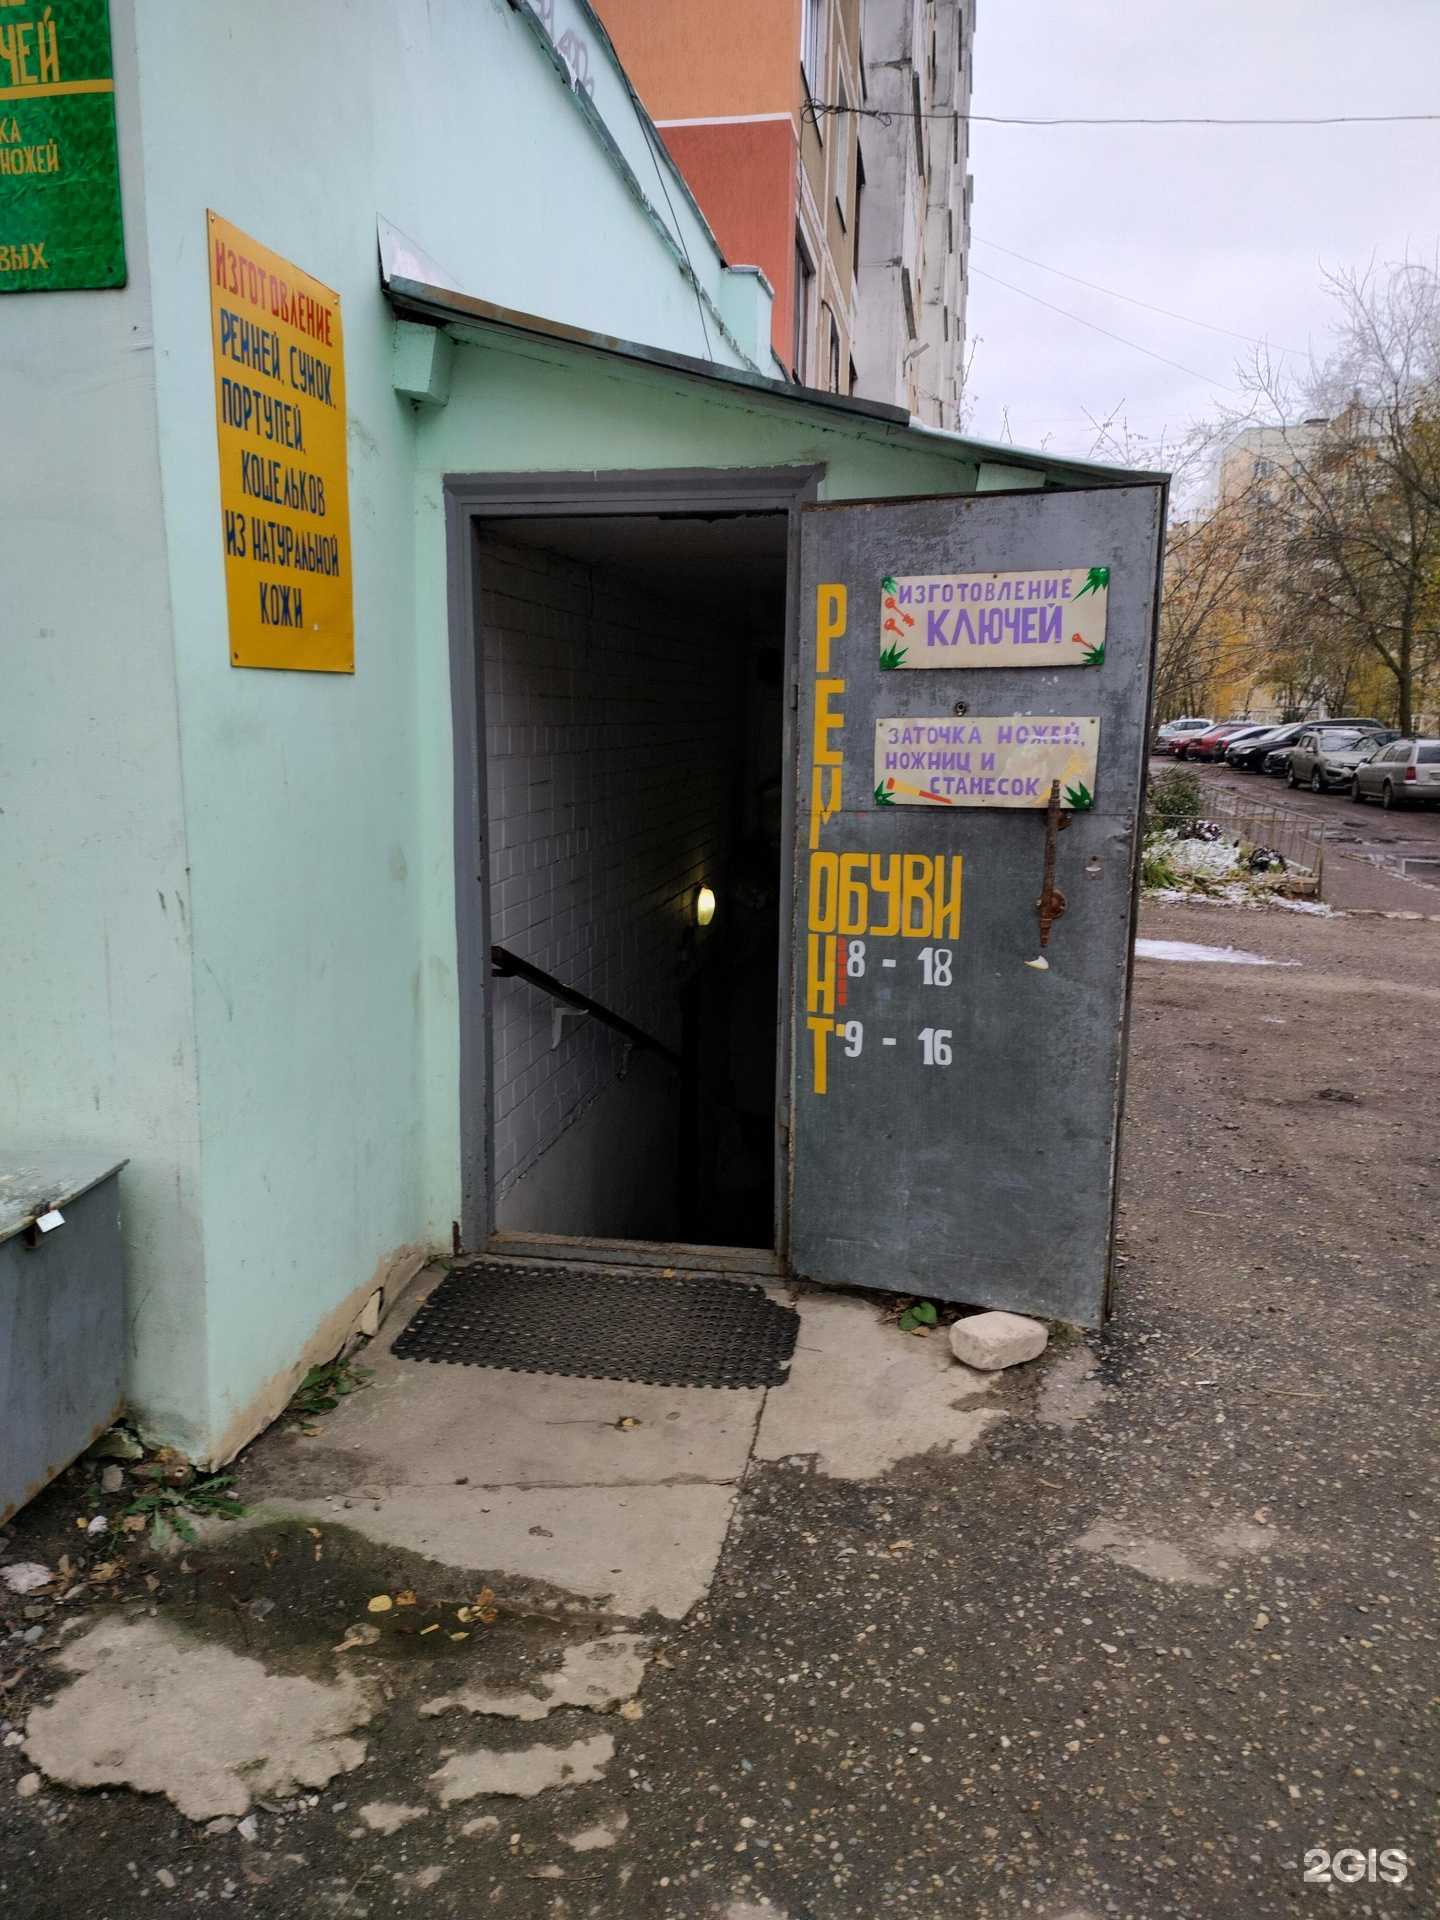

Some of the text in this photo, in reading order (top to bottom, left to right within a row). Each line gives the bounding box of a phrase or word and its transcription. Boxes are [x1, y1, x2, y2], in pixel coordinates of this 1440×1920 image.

[215, 240, 333, 348] ИЗГОТОВЛЕНИЕ
[241, 450, 326, 516] КОШЕЛЬКОВ
[225, 510, 340, 576] ИЗ НАТУРАЛЬНОЙ
[259, 582, 303, 628] КОЖИ
[899, 577, 1072, 604] ИЗГОТОВЛЕНИЕ
[927, 602, 1063, 647] КЛЮЧЕЙ
[888, 726, 982, 745] ЗАТОЧКА
[885, 752, 995, 773] НОЖНИЦ И
[930, 776, 1041, 796] СТАМЕСОК
[808, 851, 963, 940] ОБУВИ
[846, 940, 866, 978] 8
[917, 947, 953, 987] 18
[844, 1020, 864, 1058] 9
[917, 1027, 953, 1066] 16
